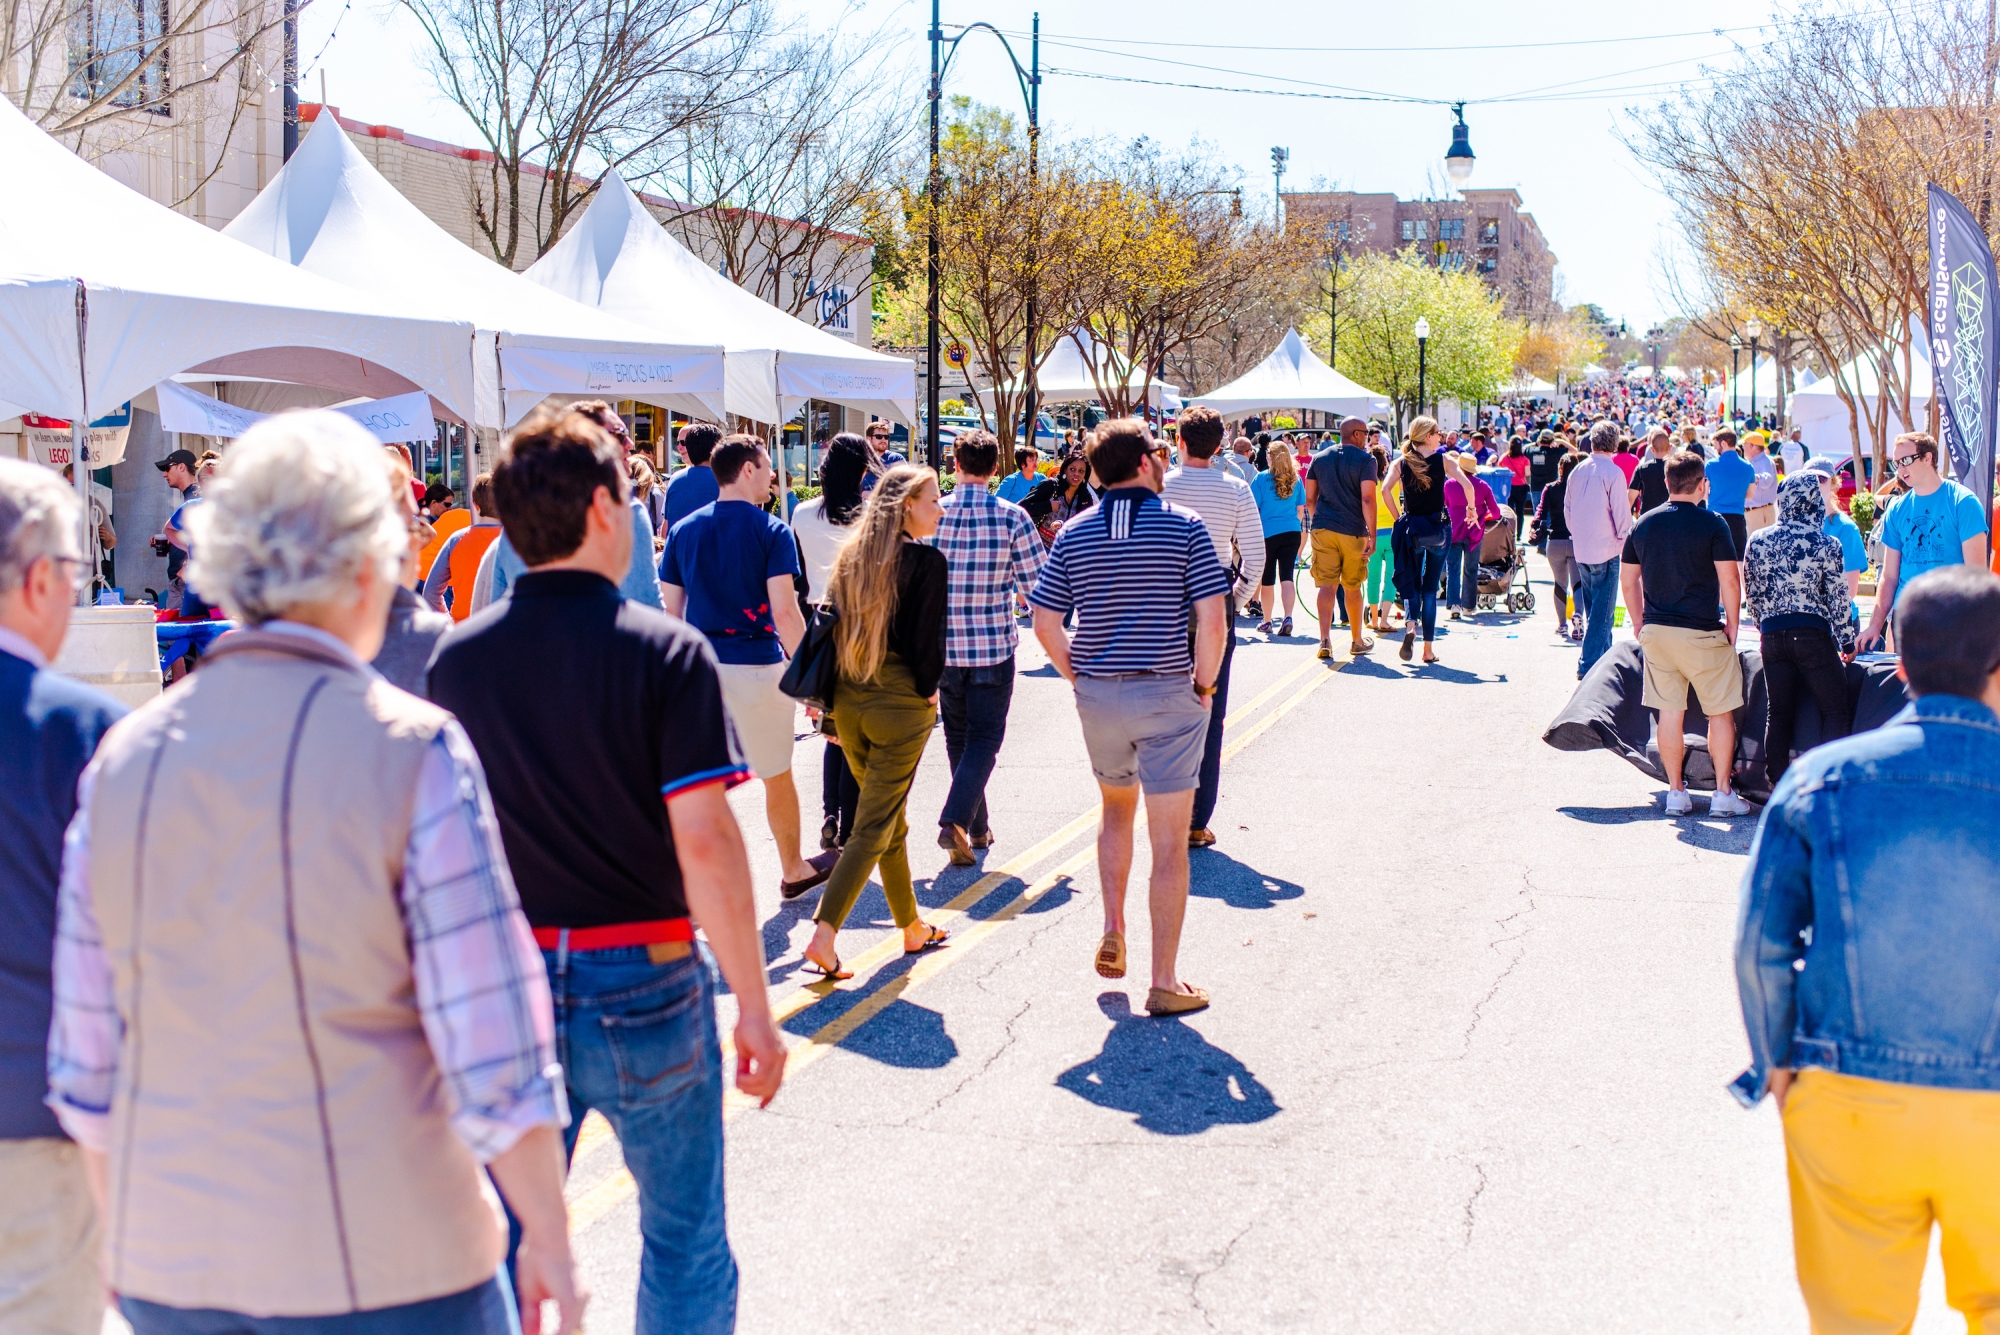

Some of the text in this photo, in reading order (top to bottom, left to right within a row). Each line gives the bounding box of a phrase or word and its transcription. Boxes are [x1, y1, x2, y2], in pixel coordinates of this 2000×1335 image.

[614, 364, 673, 382] BRICKS 4 KIDZ
[357, 411, 410, 431] HOOL
[89, 431, 103, 445] play
[104, 430, 117, 441] with
